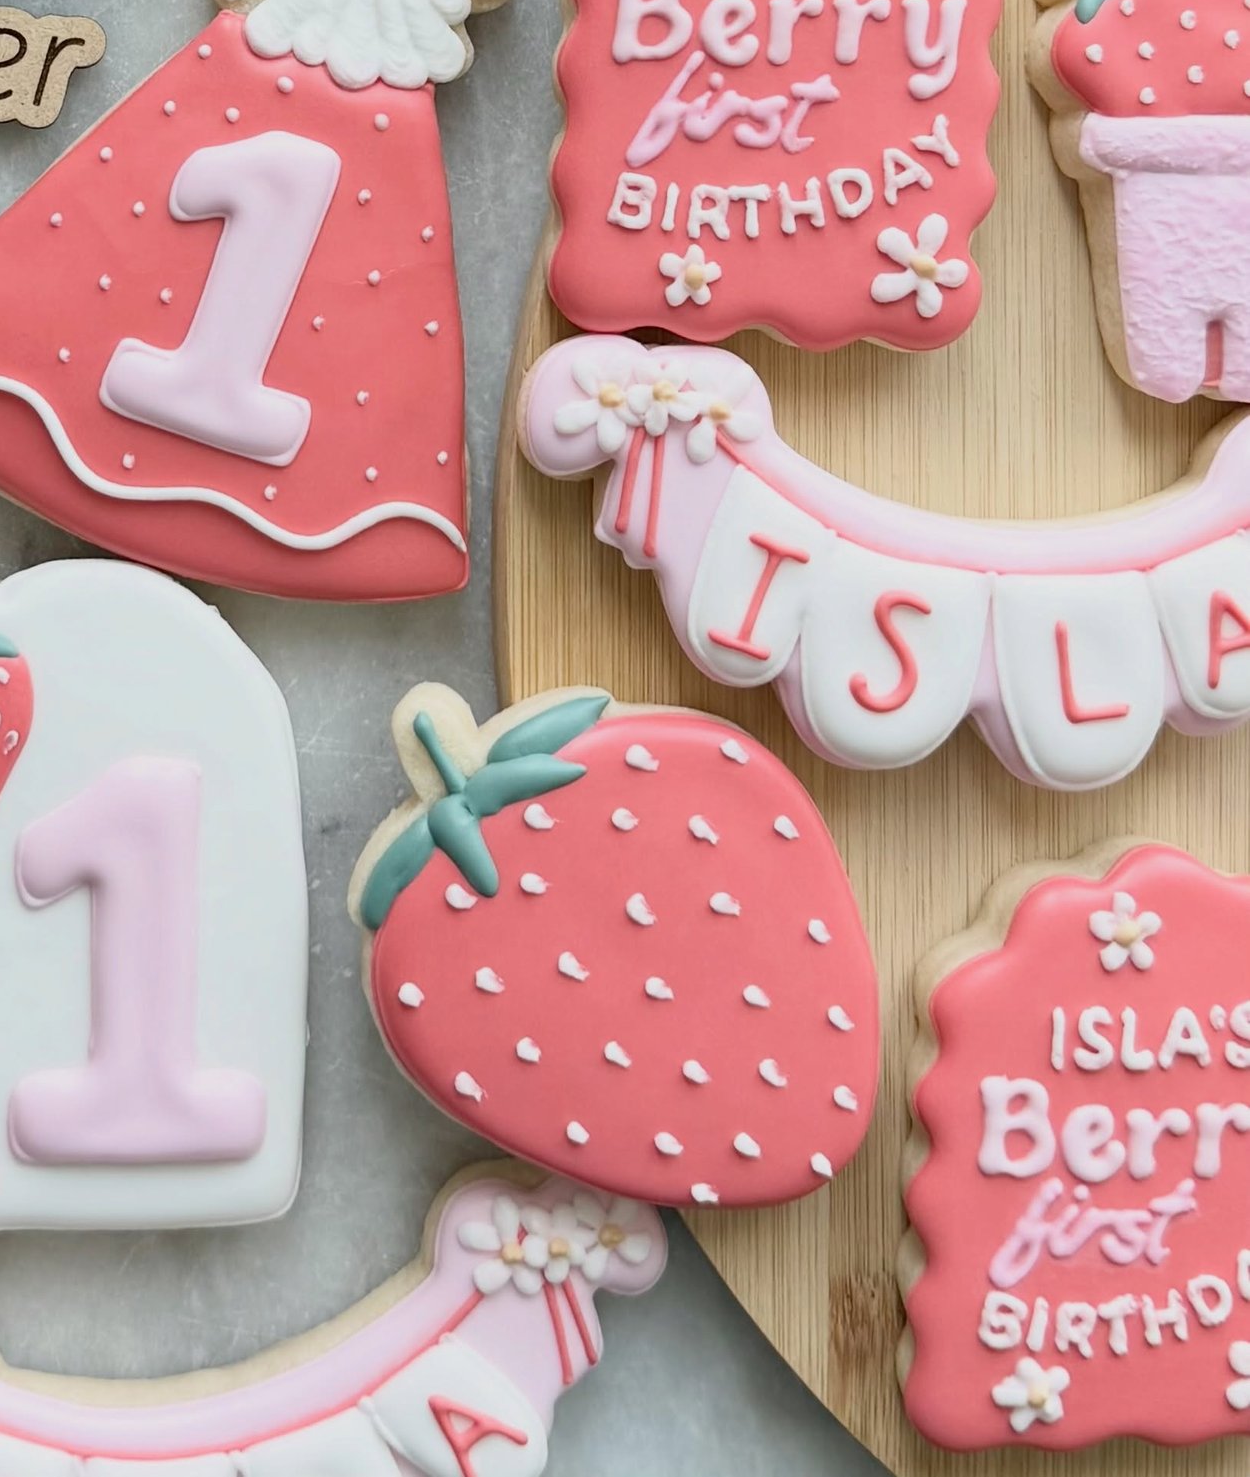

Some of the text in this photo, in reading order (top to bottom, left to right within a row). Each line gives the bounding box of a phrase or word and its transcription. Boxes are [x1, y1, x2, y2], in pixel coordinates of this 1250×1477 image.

[625, 51, 840, 167] first
[607, 114, 960, 240] BIRTHDAY
[99, 130, 342, 467] 1
[7, 754, 267, 1166] 1
[988, 1177, 1198, 1289] first
[978, 1249, 1250, 1359] BIRTHD
